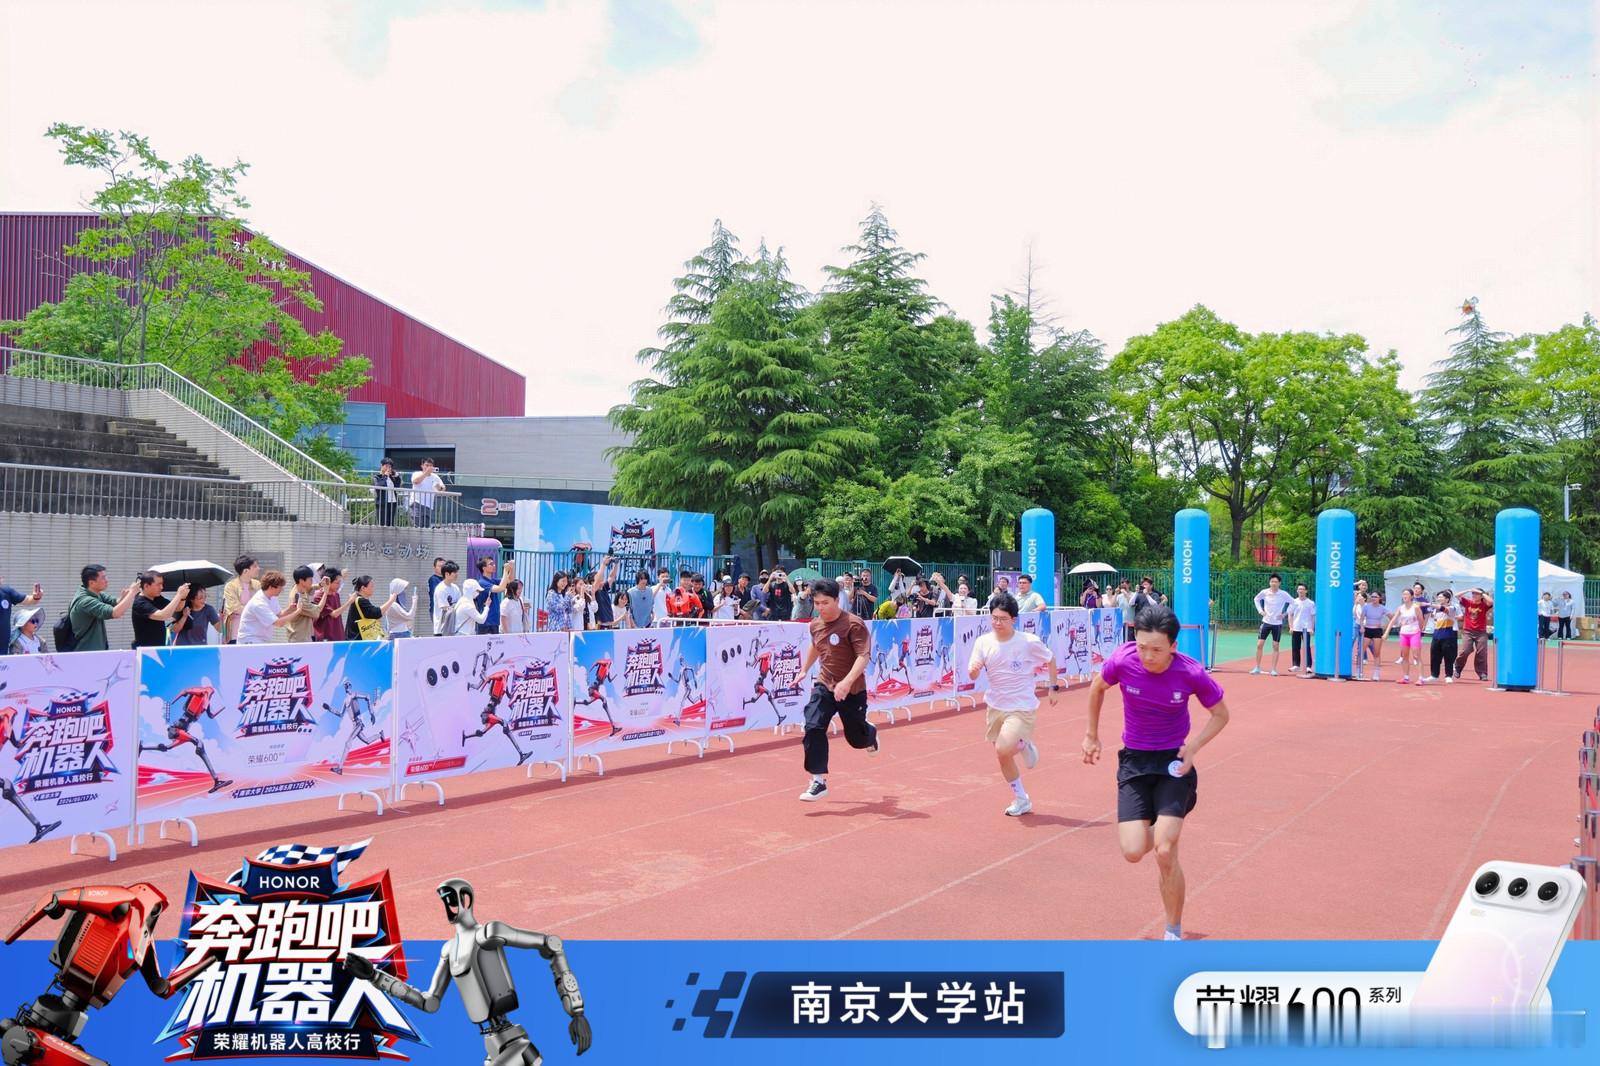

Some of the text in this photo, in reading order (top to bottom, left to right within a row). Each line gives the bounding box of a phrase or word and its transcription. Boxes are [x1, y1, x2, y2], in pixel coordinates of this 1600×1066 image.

[1182, 540, 1192, 584] HONOR
[1329, 542, 1341, 588] HONOR
[1504, 544, 1517, 594] HONOR
[241, 676, 311, 706] 奔跑吧
[510, 678, 557, 703] 奔跑吧
[56, 706, 82, 714] HONOR
[240, 698, 316, 725] 机器人
[511, 697, 561, 721] 机器人
[20, 713, 110, 754] 奔跑吧
[19, 741, 117, 778] 机器人
[34, 772, 94, 789] 荣耀机器人高校行
